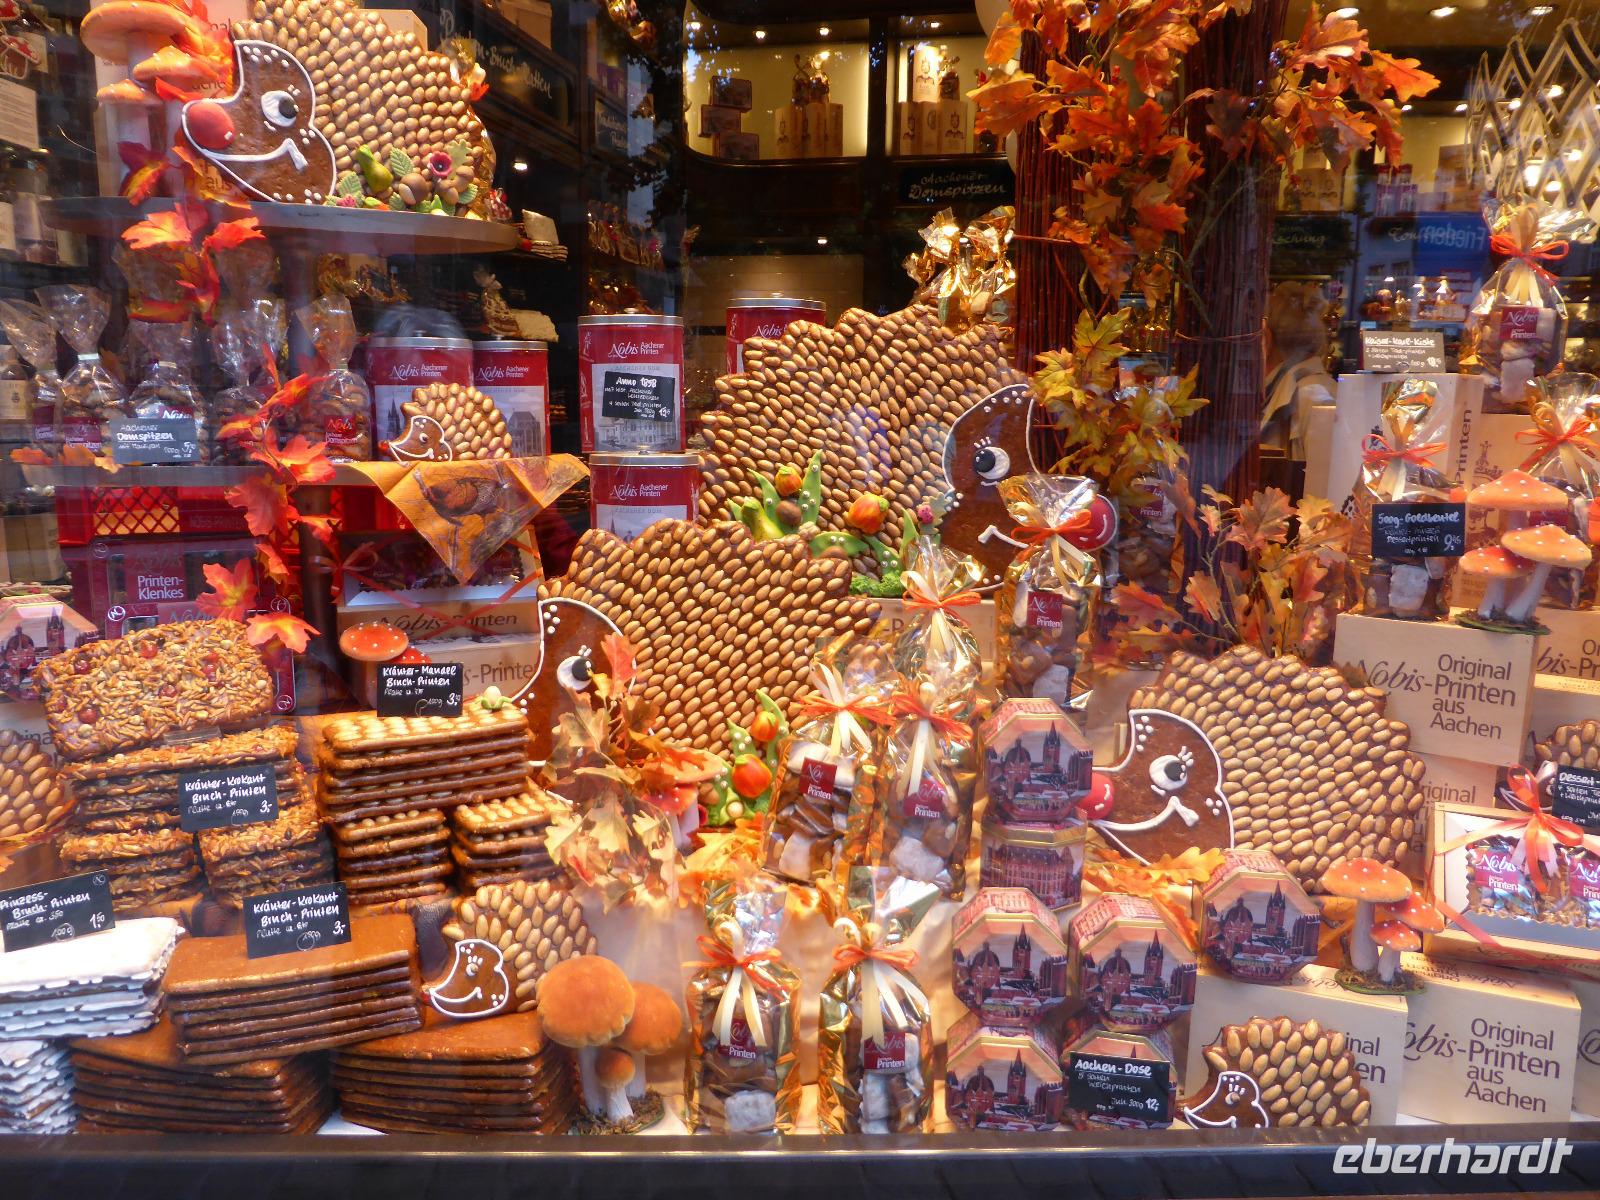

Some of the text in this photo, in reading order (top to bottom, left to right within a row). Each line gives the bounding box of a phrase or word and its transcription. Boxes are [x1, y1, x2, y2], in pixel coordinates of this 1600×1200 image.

[752, 323, 782, 340] Nobis
[608, 341, 639, 359] Nobis
[641, 341, 665, 349] Aachener
[390, 364, 420, 381] Nobis
[421, 363, 448, 371] Aachener
[476, 366, 505, 382] Nobis
[116, 432, 174, 443] Domspitzen
[610, 483, 638, 501] Nobis
[640, 483, 668, 491] Aachener
[138, 575, 185, 587] Printen-
[138, 587, 185, 600] Klenkes
[1036, 618, 1063, 628] Printen
[1438, 654, 1512, 681] Original
[1432, 698, 1465, 715] aus
[1430, 711, 1502, 740] Aachen
[807, 785, 833, 800] Printen
[1421, 781, 1476, 804] riginal
[914, 804, 940, 818] Printen
[1475, 853, 1517, 874] Nobis
[1488, 876, 1519, 892] Printen
[1470, 1017, 1555, 1051] Original
[728, 1046, 756, 1059] Printen
[1403, 1021, 1561, 1079] obis-Printen
[877, 1057, 905, 1069] Printen
[1466, 1064, 1504, 1085] aus
[1464, 1080, 1547, 1113] Aachen
